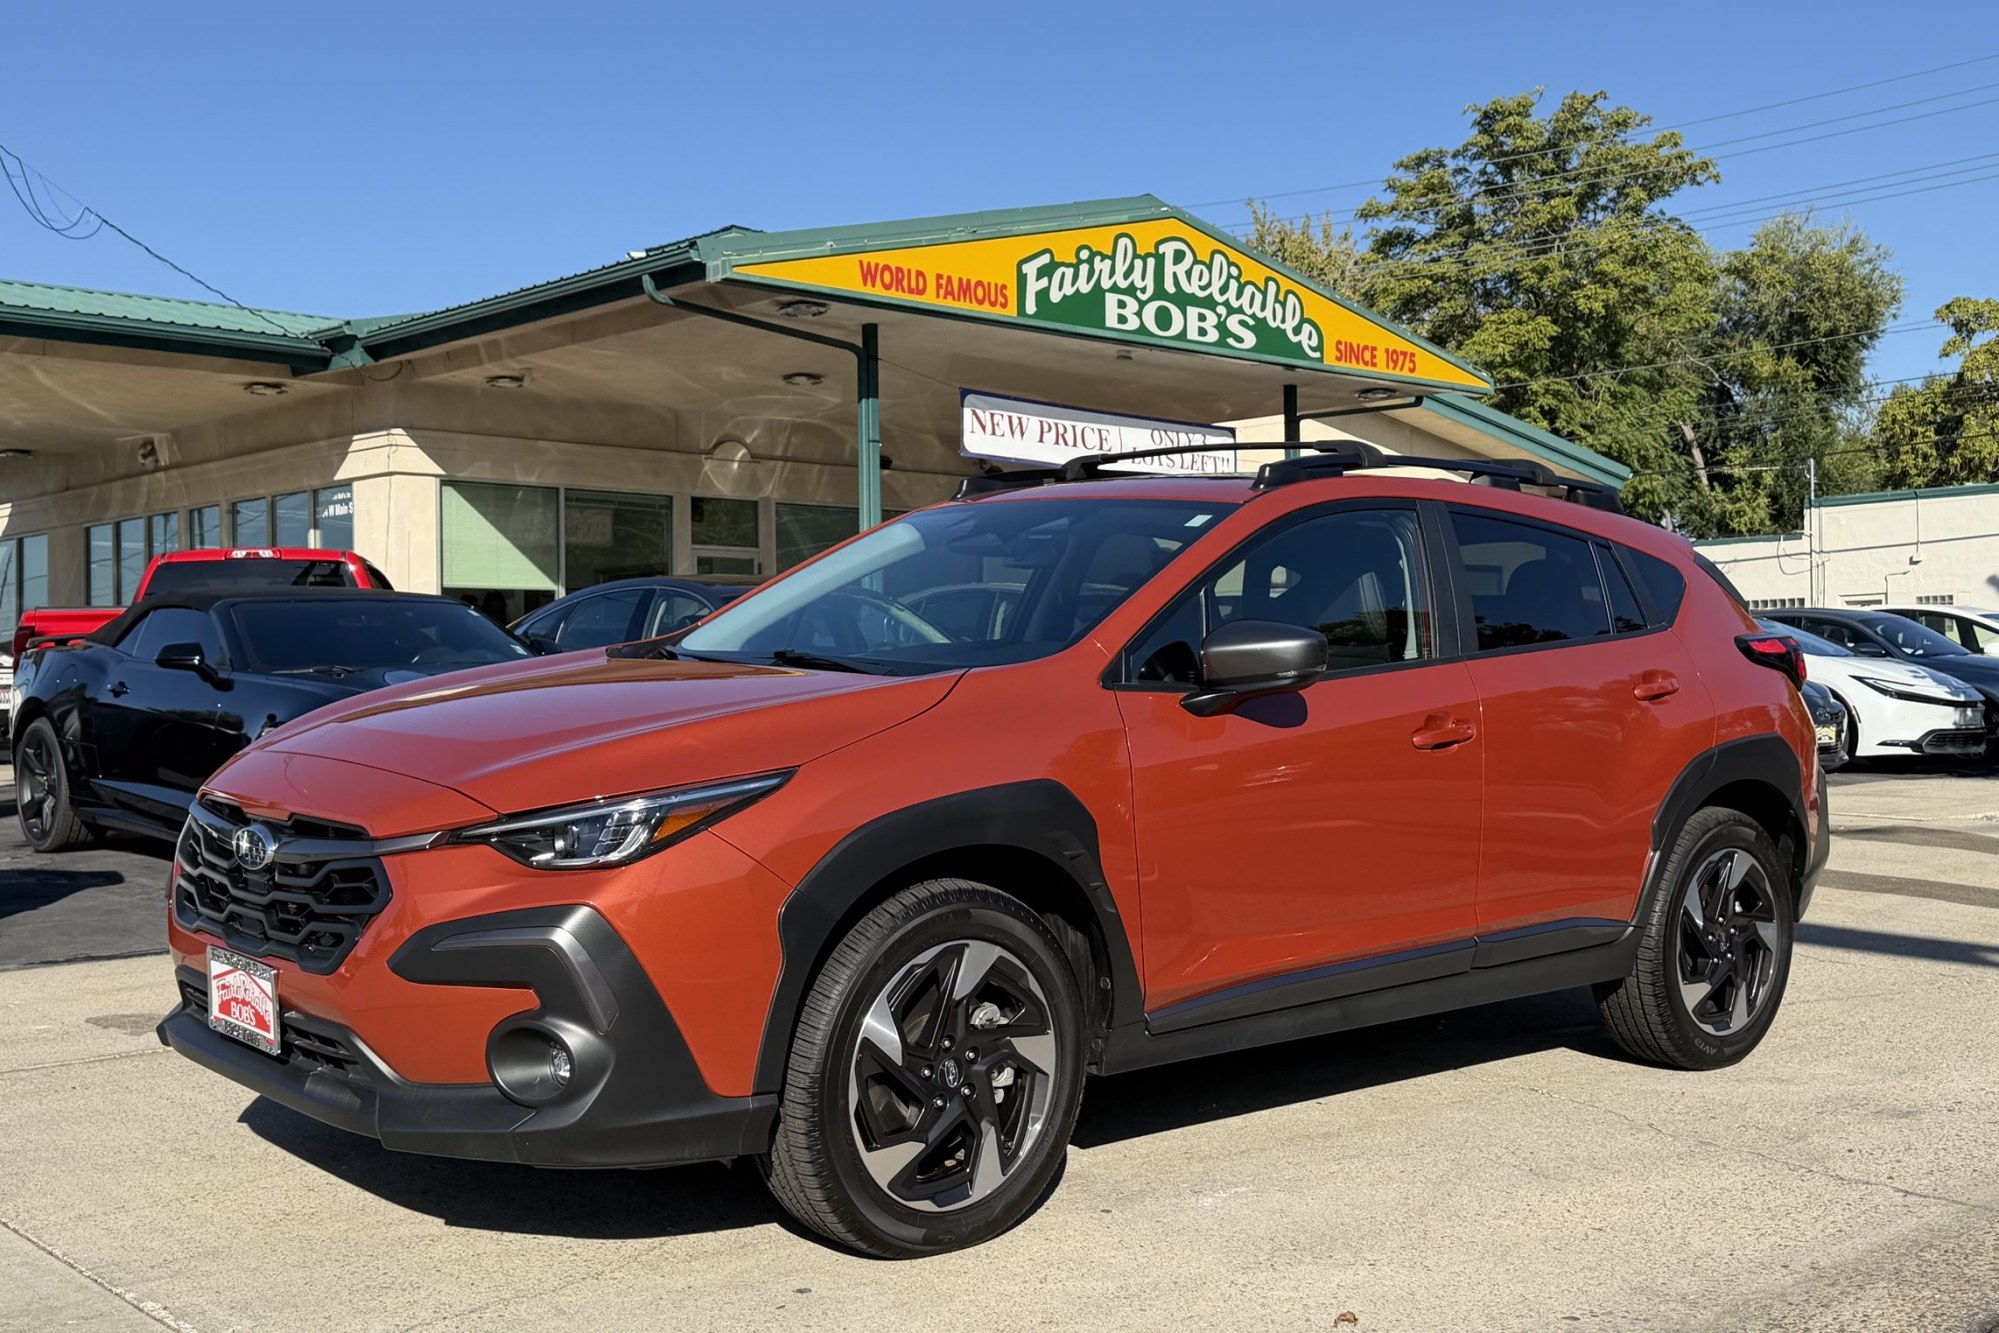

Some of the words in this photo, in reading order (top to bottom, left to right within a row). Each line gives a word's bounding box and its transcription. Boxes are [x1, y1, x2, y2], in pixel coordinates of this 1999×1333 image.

[858, 259, 928, 296] WORLD
[935, 273, 1009, 310] FAMOUS
[1021, 236, 1156, 315] Fairly
[1158, 240, 1321, 358] Reliable
[1104, 292, 1257, 350] BOB'S
[1334, 339, 1378, 368] SINCE
[1384, 347, 1417, 374] 1975
[969, 408, 1030, 442] NEW
[1037, 419, 1113, 453] PRICE
[1150, 427, 1195, 448] ONLY
[230, 1000, 256, 1027] BOB'S
